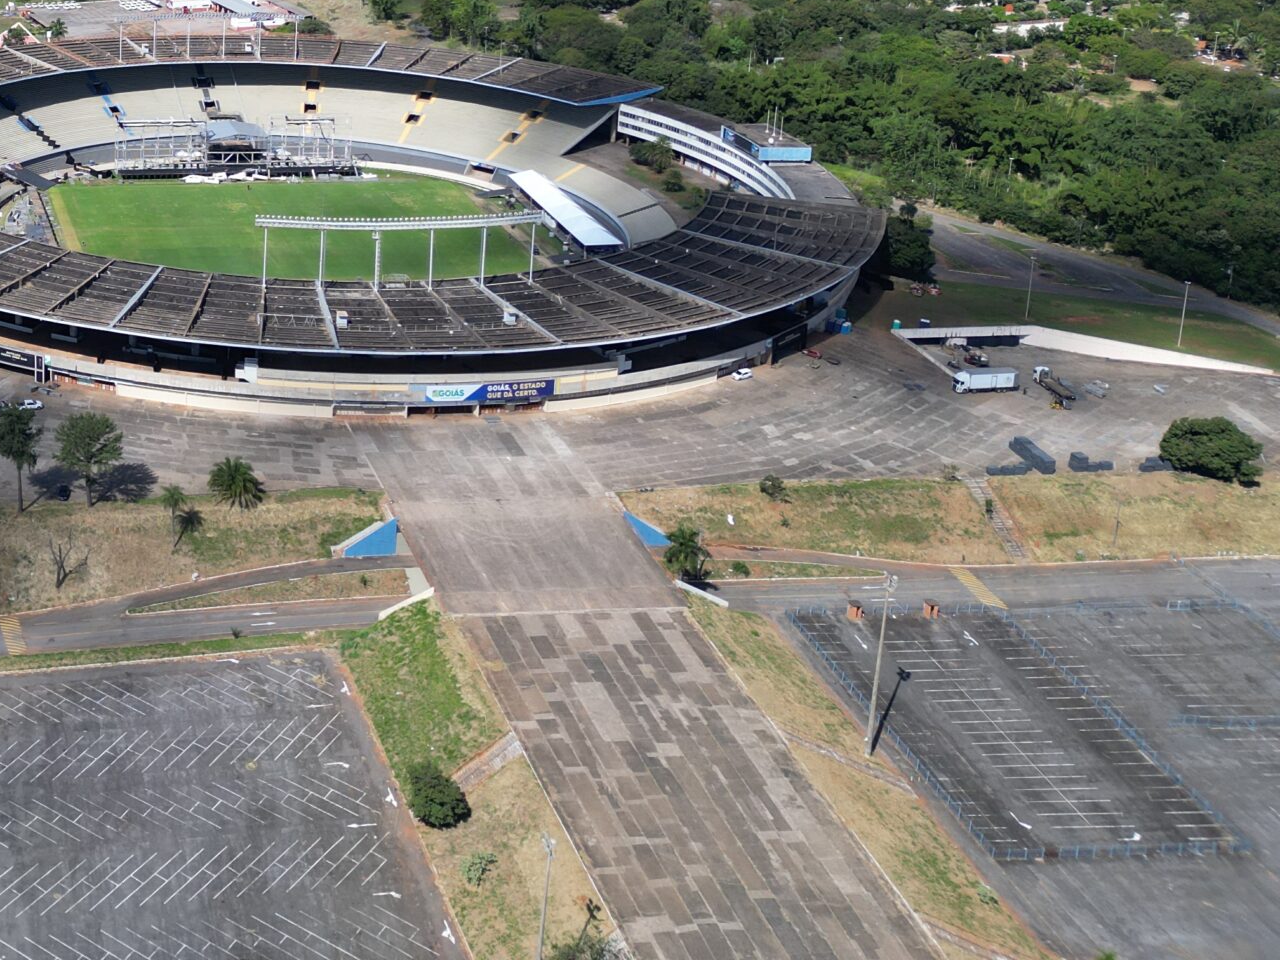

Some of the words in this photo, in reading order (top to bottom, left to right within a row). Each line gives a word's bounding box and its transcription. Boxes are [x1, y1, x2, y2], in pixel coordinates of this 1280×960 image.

[520, 381, 546, 389] ESTADO
[438, 389, 464, 397] GOIÁS
[487, 391, 502, 399] QUE
